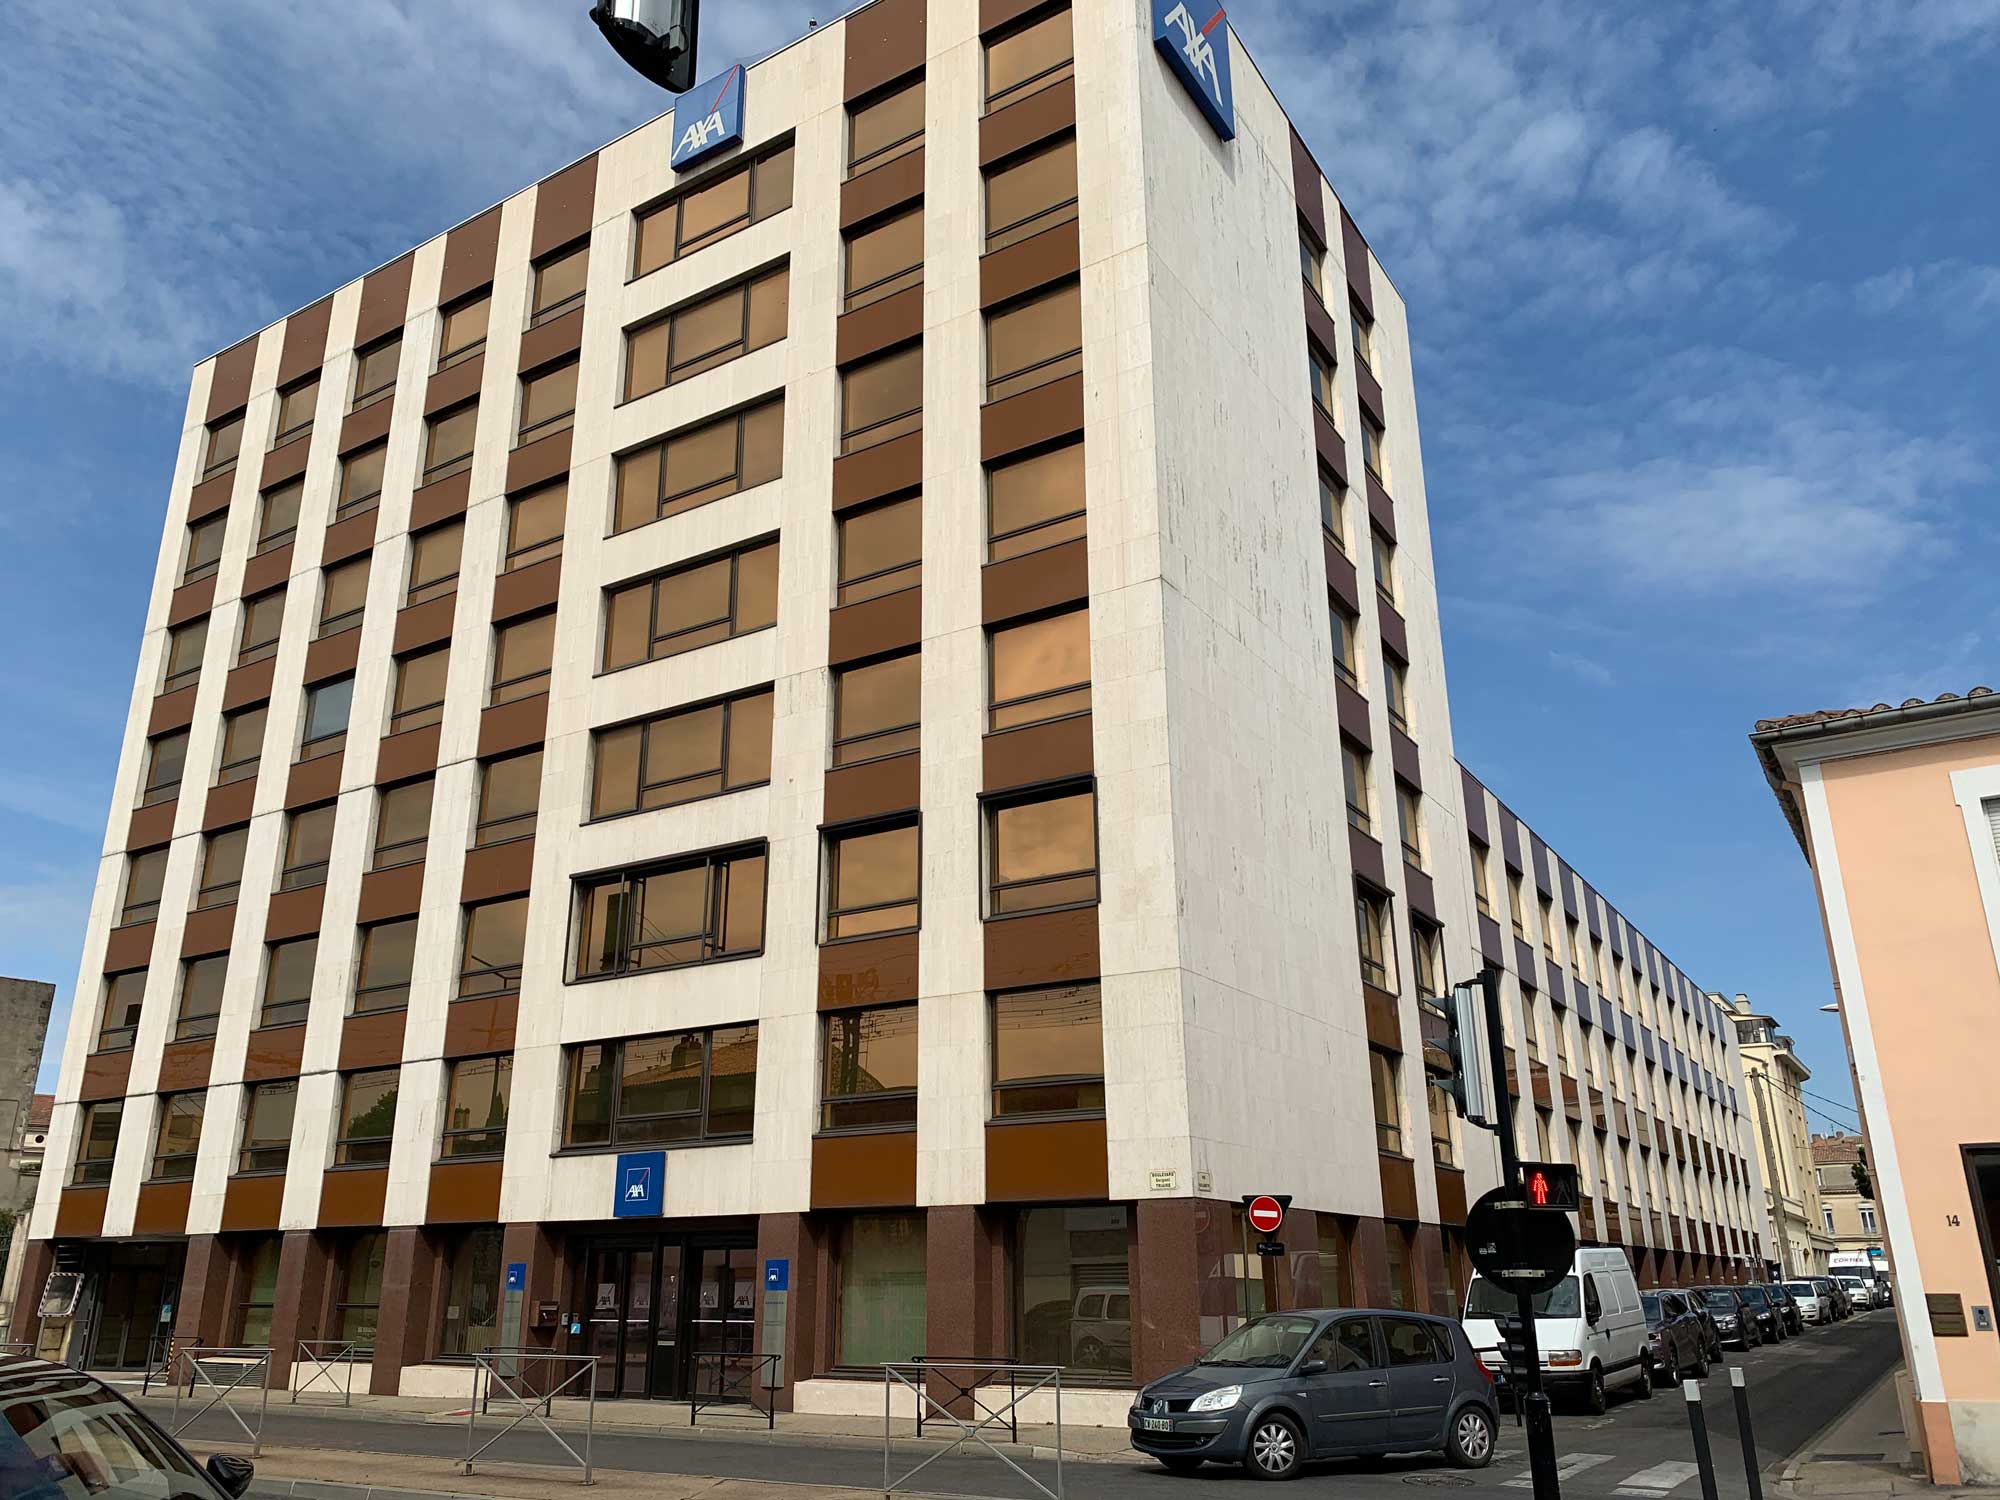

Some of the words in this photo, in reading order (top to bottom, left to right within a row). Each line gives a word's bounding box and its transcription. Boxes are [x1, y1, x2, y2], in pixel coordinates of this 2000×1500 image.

[1164, 1, 1223, 108] AXA
[672, 110, 726, 161] AXA
[625, 1184, 644, 1198] AXA
[1946, 1214, 1961, 1227] 14
[735, 1295, 750, 1306] AXA
